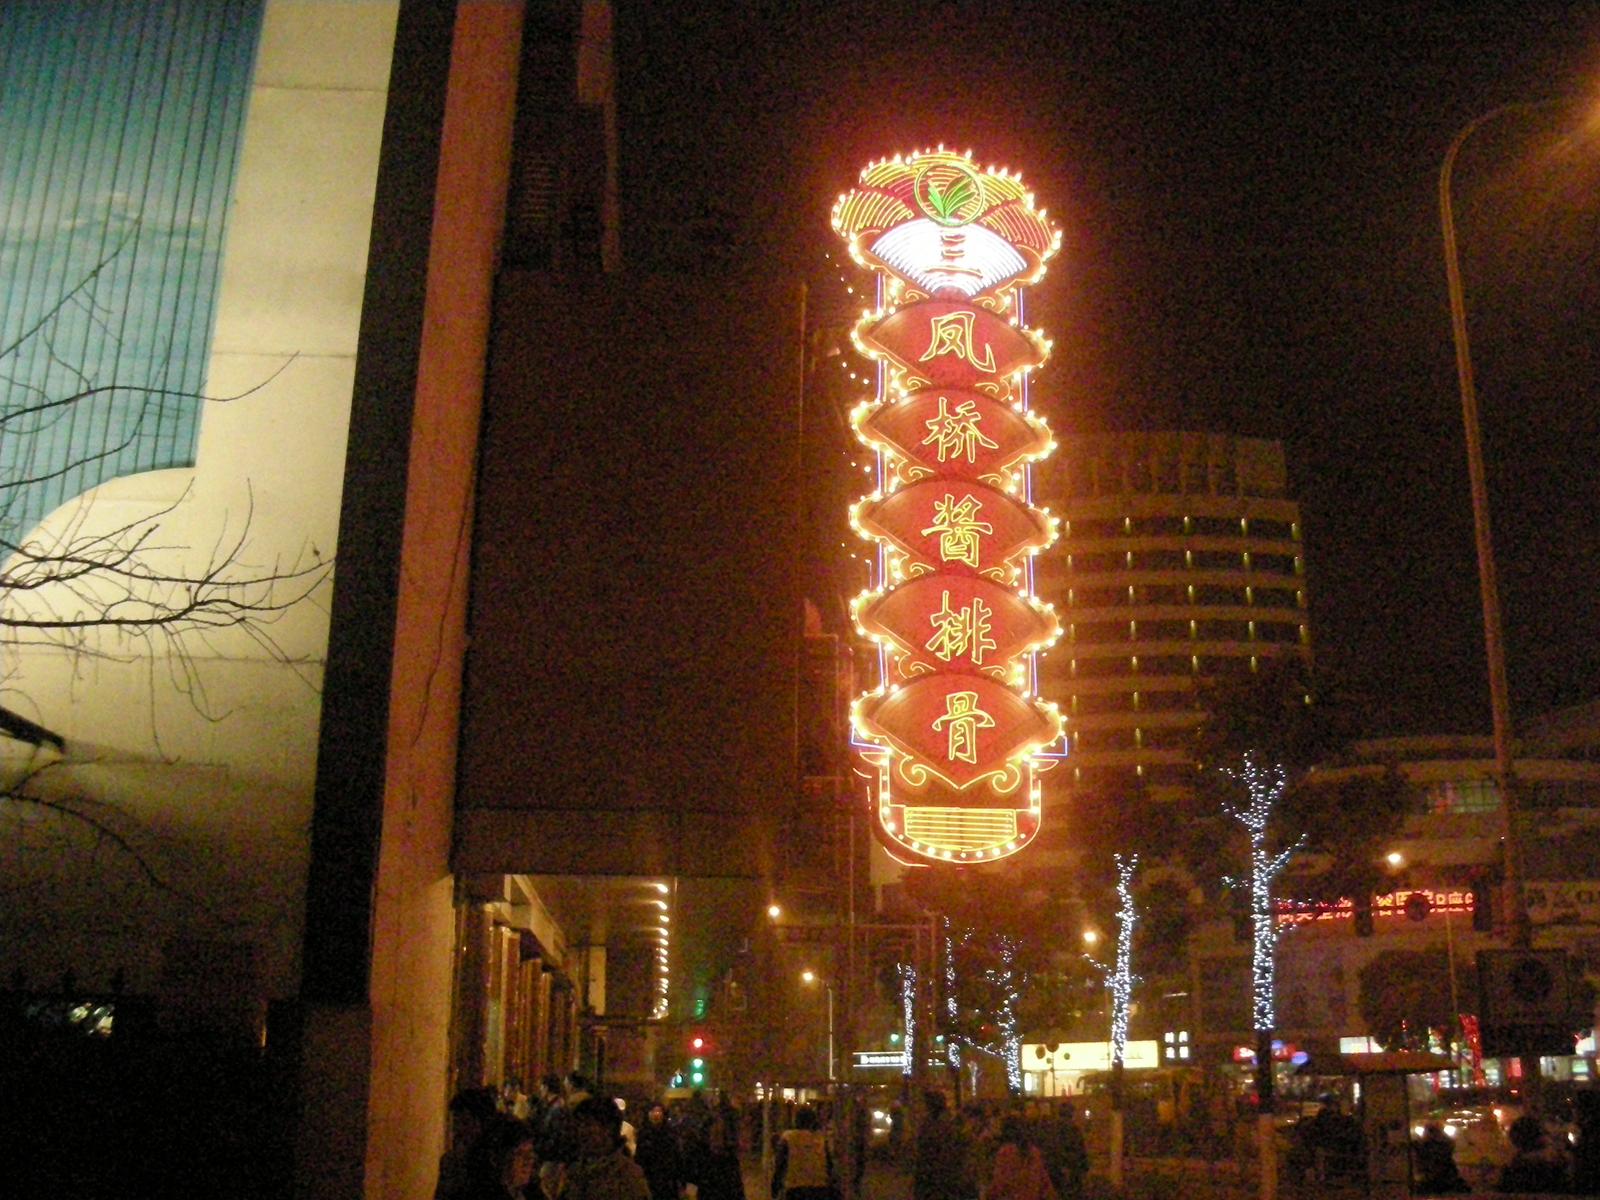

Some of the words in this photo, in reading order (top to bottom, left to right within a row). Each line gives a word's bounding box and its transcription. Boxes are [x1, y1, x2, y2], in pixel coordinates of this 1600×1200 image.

[919, 311, 999, 764] 凤桥酱排骨
